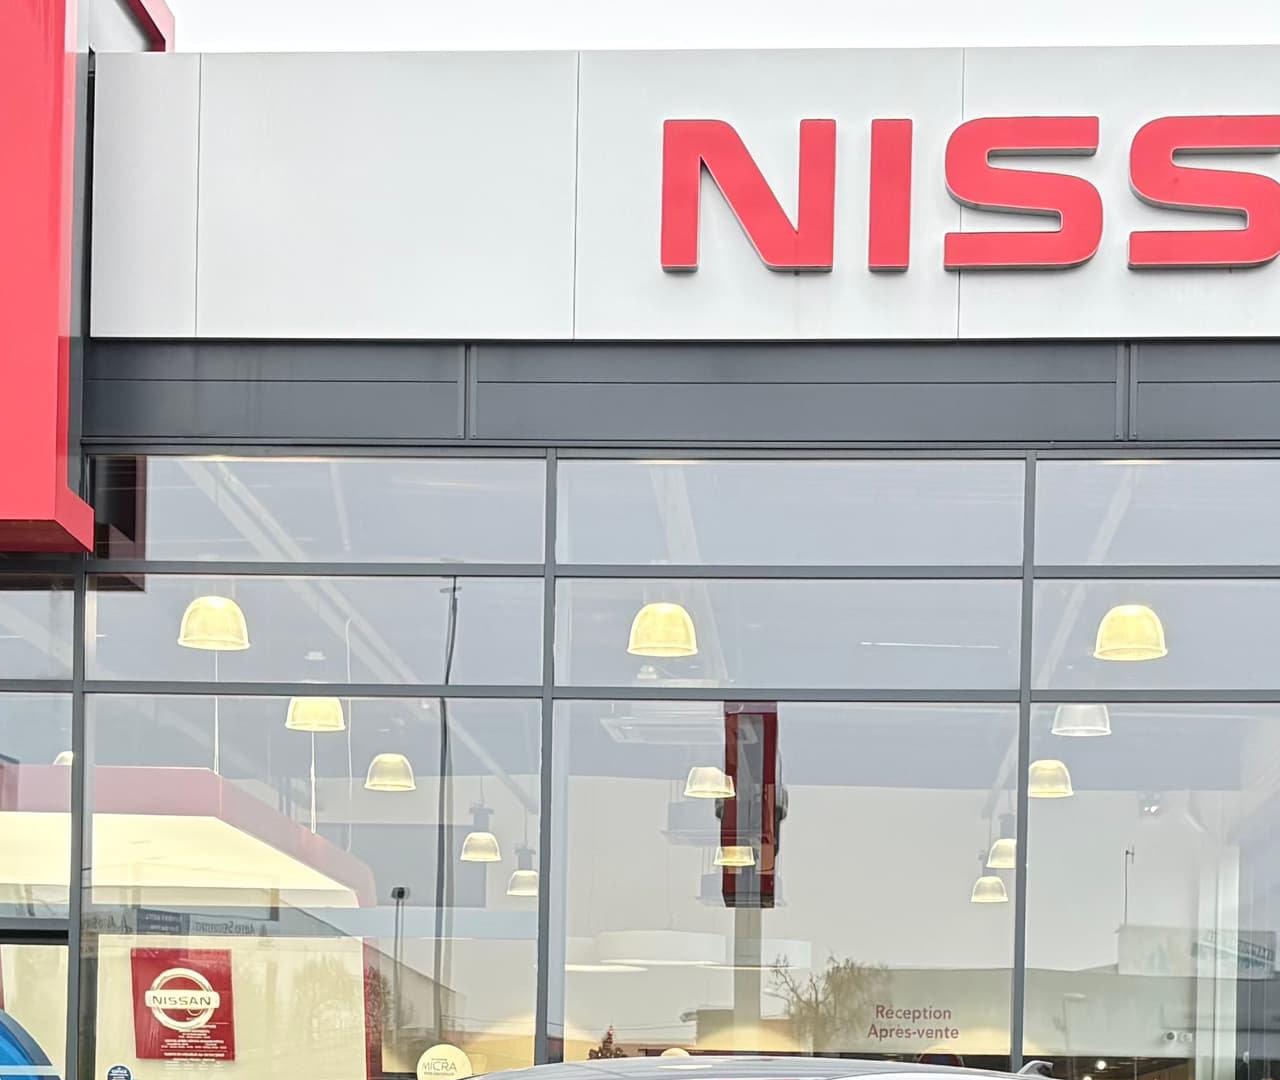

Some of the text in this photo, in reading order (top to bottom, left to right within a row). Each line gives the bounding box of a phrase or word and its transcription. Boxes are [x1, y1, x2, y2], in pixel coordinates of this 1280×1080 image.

[152, 996, 211, 1006] NISSAN
[876, 1004, 952, 1023] Réception
[867, 1023, 960, 1042] Après-vente
[422, 1061, 458, 1073] MICRA
